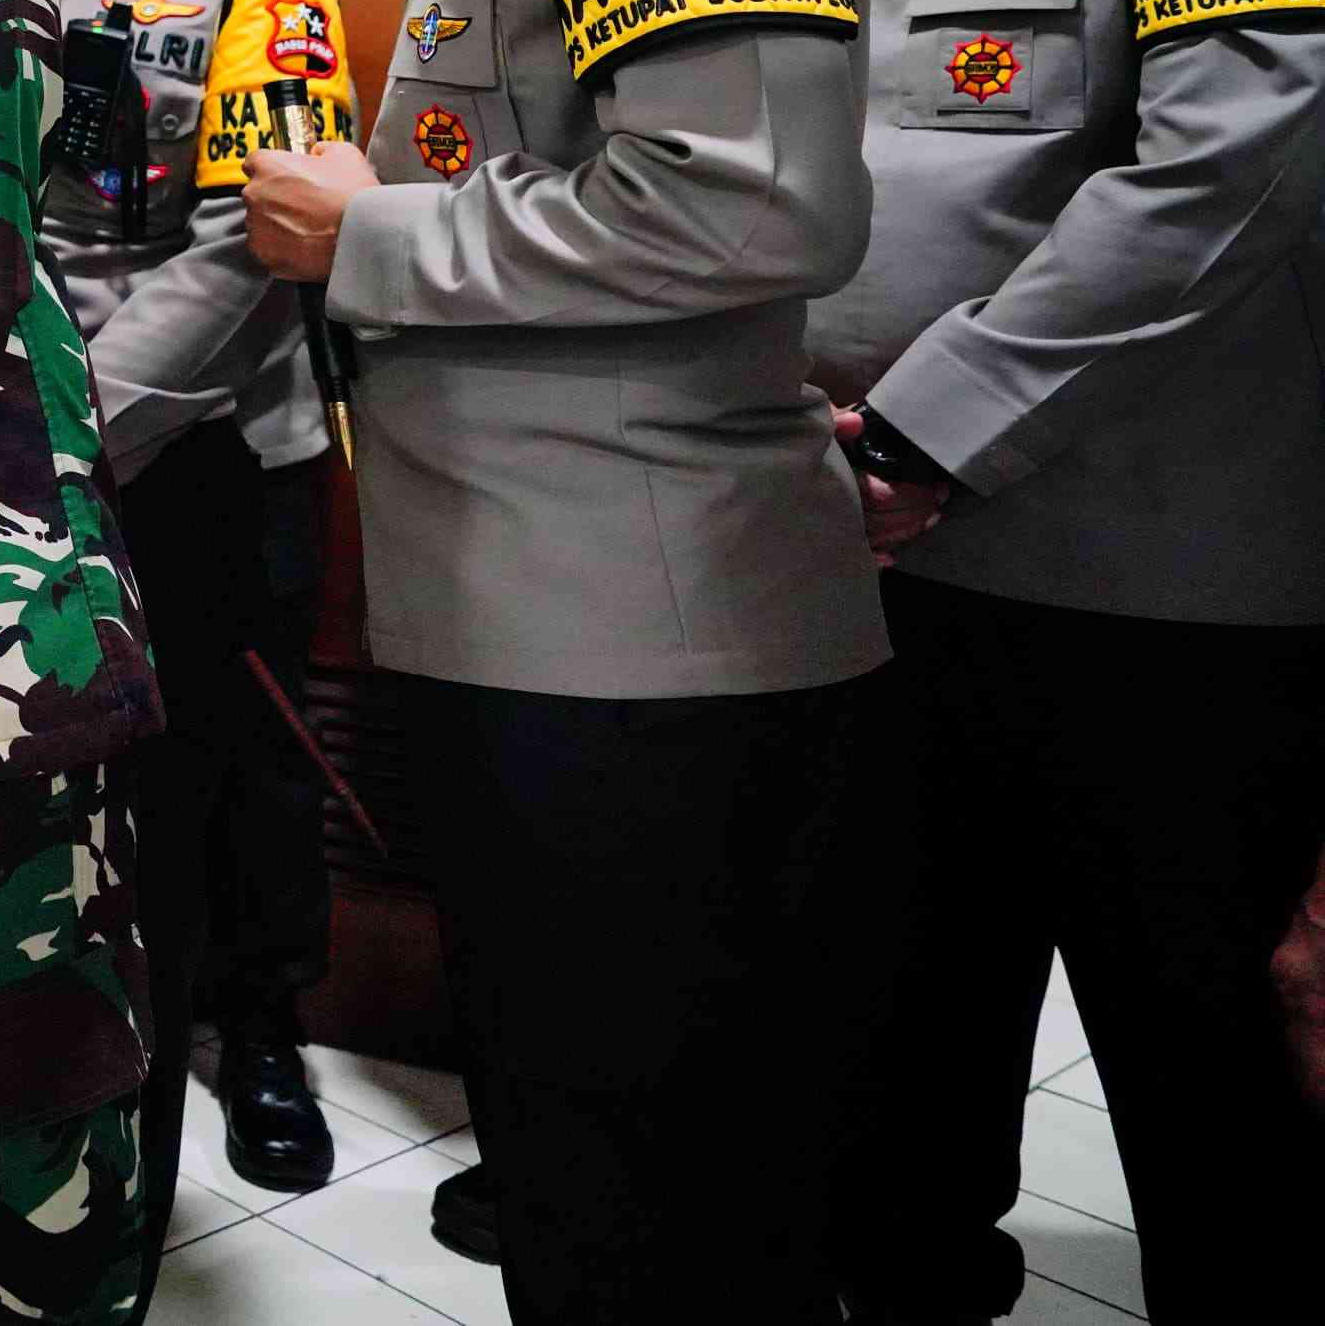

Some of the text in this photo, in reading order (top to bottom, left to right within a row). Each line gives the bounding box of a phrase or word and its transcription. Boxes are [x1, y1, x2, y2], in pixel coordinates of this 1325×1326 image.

[135, 30, 205, 70] LRI
[220, 92, 260, 129] KA
[207, 130, 248, 162] OPS
